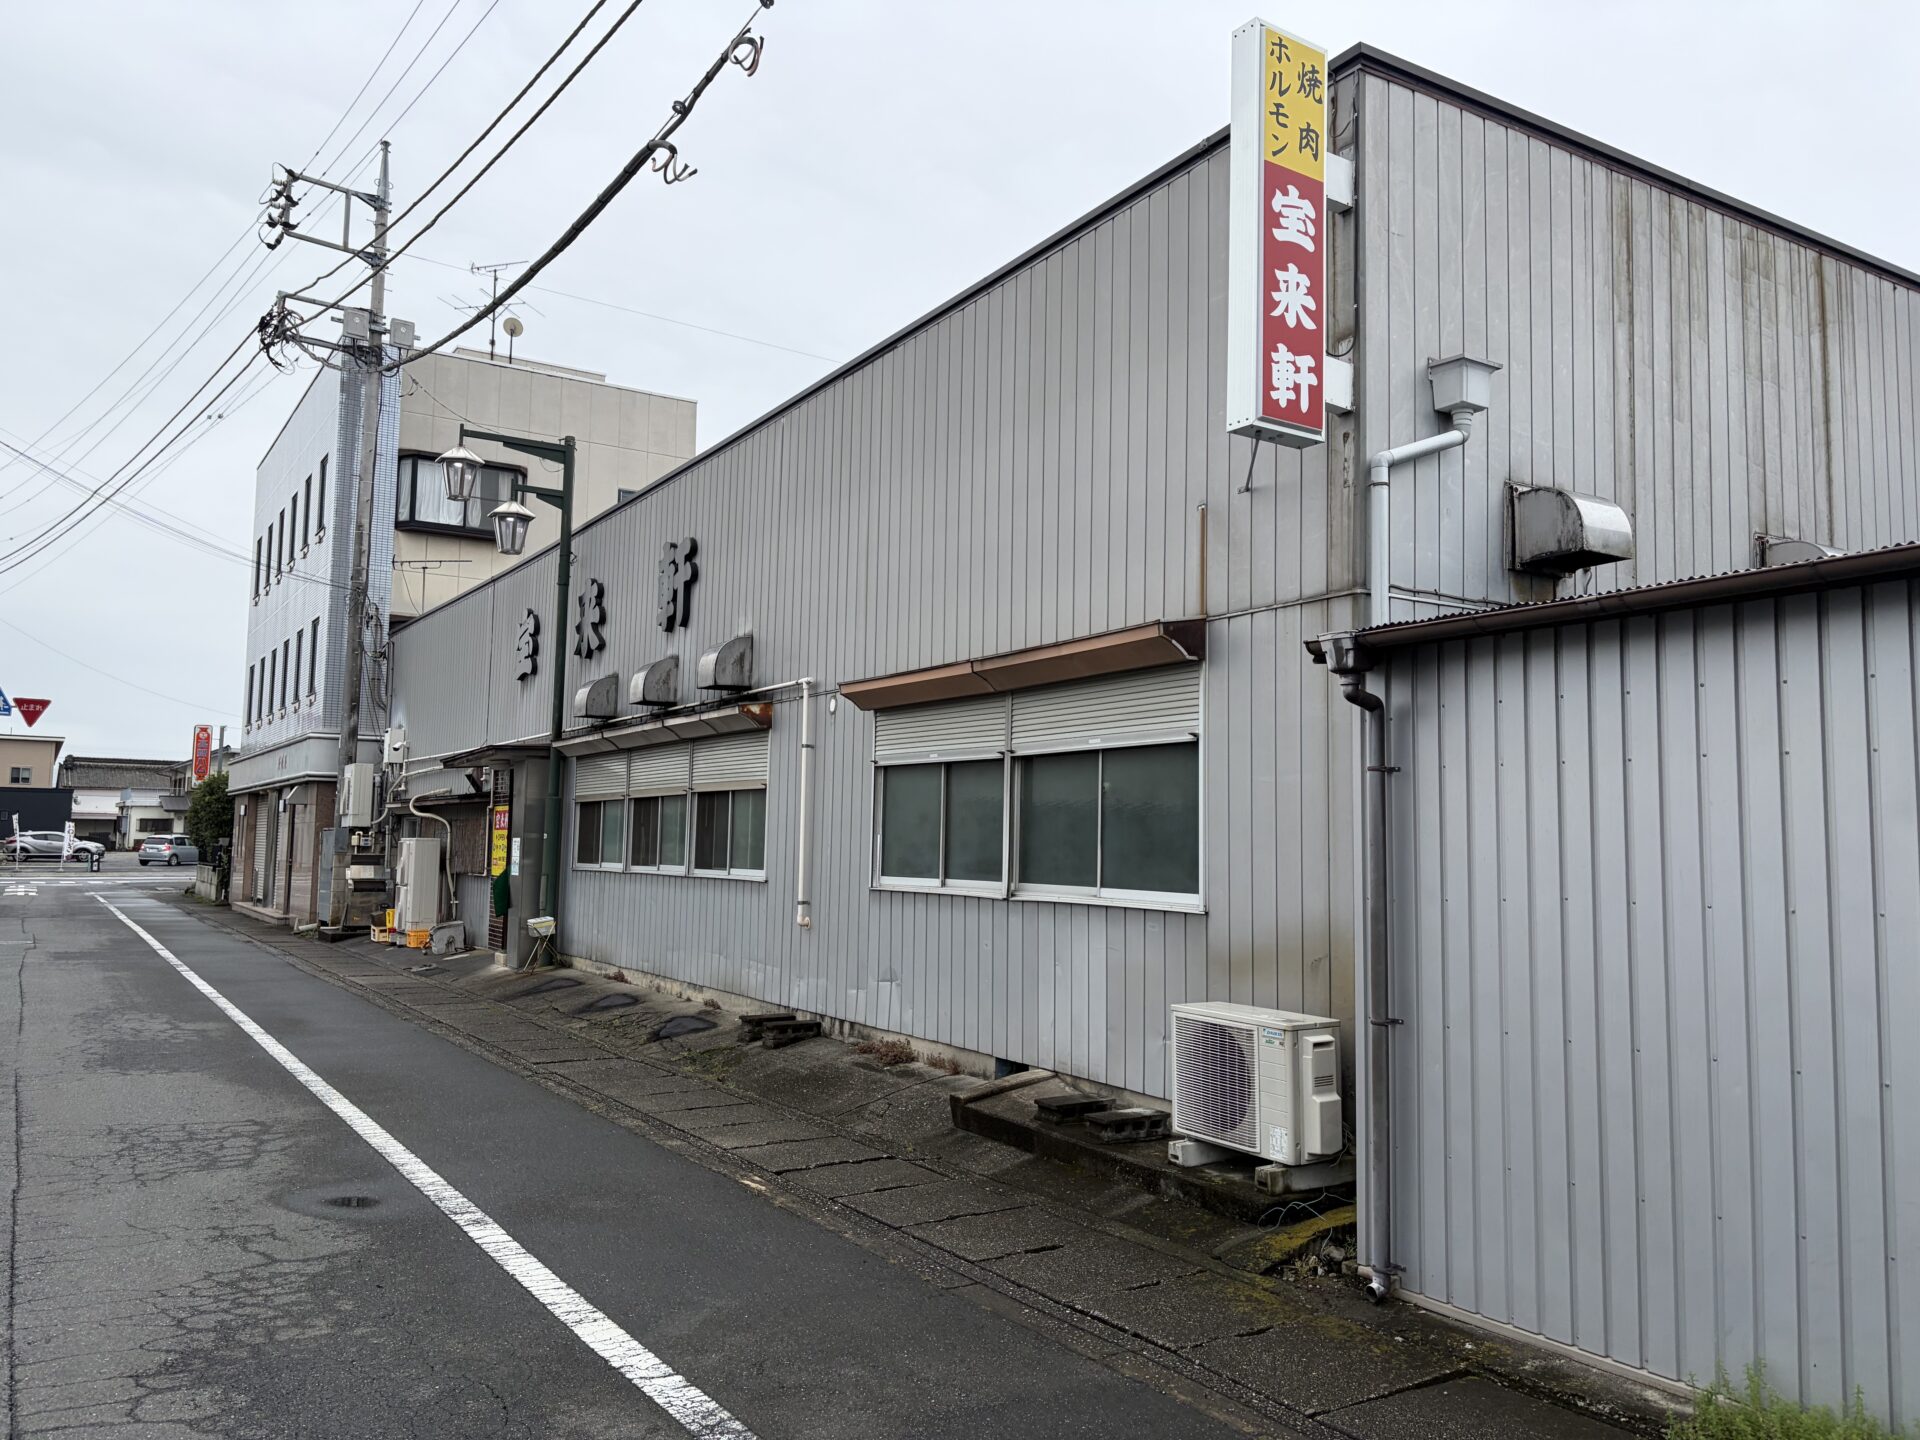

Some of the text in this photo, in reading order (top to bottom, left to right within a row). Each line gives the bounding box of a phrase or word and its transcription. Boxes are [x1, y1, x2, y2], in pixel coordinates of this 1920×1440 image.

[1268, 35, 1292, 158] ホルモン
[1296, 61, 1324, 163] 焼肉
[1270, 184, 1318, 414] 宝来軒
[515, 536, 699, 682] 宝来軒
[20, 703, 43, 711] 止まれ
